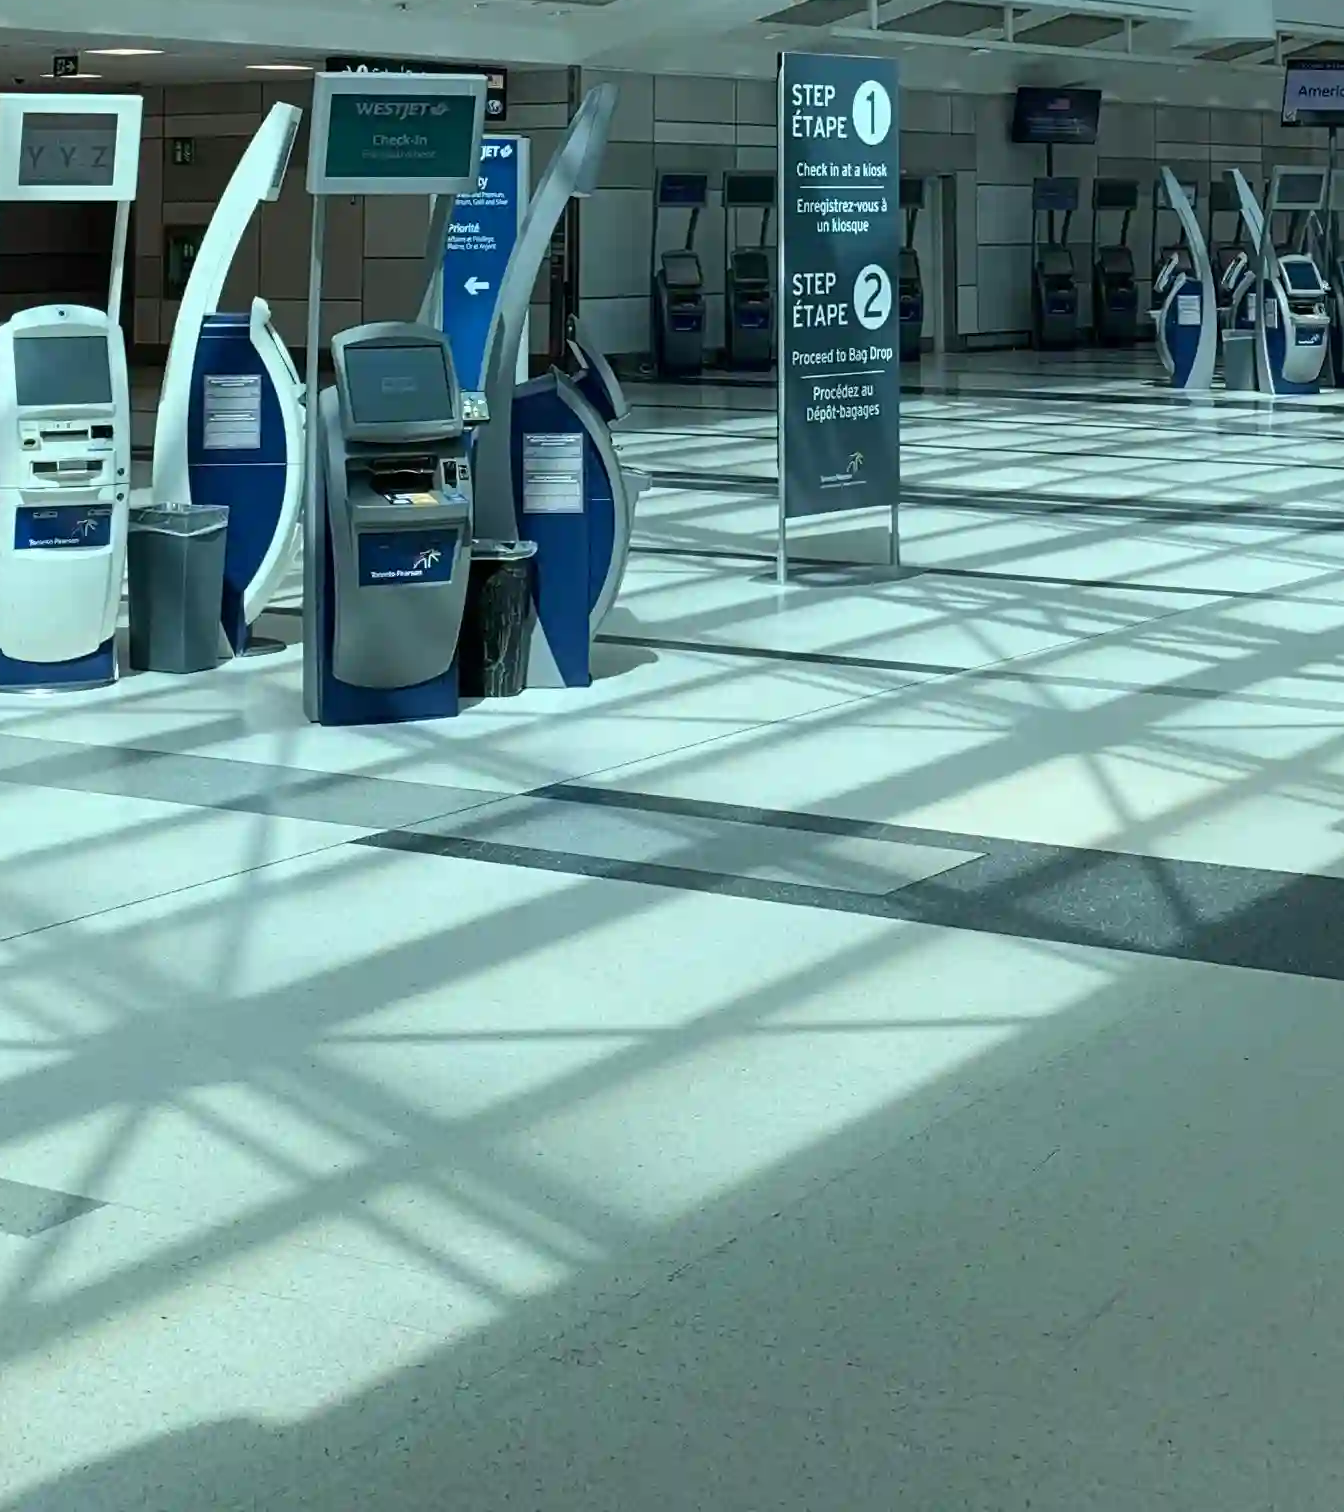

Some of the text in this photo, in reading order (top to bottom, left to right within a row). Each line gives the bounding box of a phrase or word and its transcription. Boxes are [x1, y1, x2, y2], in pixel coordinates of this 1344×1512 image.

[792, 84, 836, 107] STEP
[355, 102, 429, 120] WESTJET
[792, 90, 875, 139] ÉTAPE 1
[796, 162, 887, 177] Check in at a kiosk
[796, 198, 887, 216] Enregistrez-vous à
[817, 217, 869, 234] un kiosque
[792, 272, 837, 296] STEP
[792, 272, 882, 328] ÉTAPE 2
[792, 346, 893, 366] Proceed to Bag Drop
[813, 384, 873, 401] Procédez au
[806, 403, 880, 424] Dépôt-bagages
[371, 570, 395, 579] Toronto
